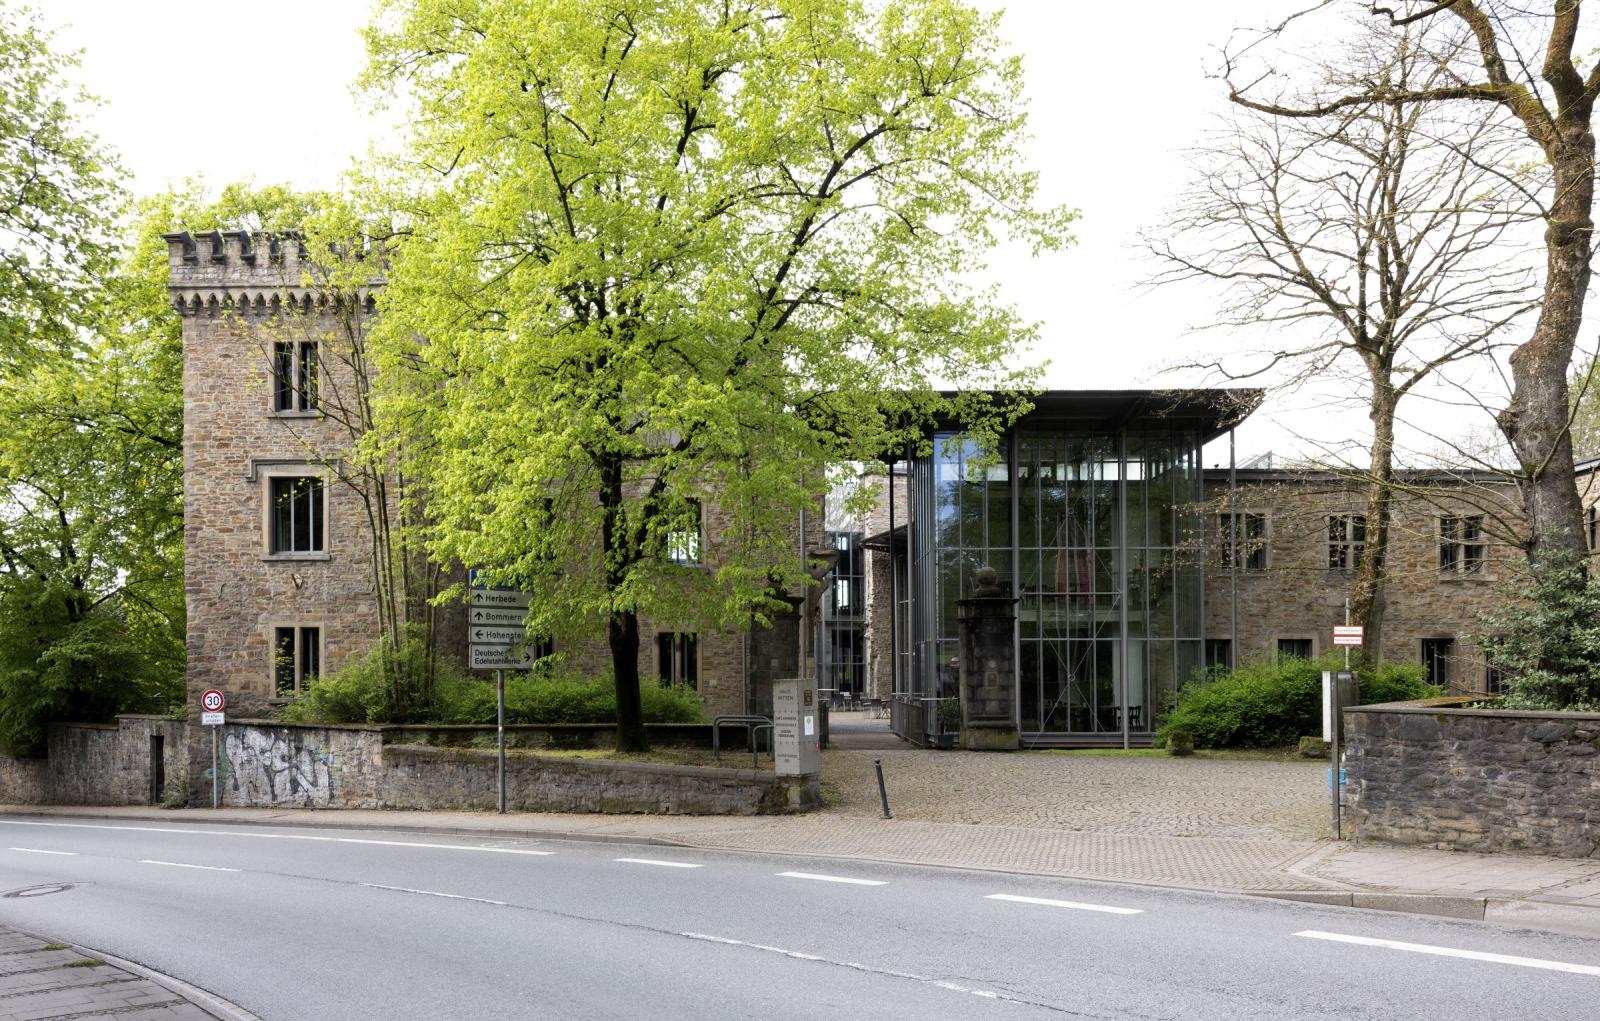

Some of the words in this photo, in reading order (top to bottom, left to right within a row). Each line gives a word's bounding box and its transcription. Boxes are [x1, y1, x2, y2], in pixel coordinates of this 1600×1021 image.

[485, 594, 517, 603] Herbede
[485, 612, 522, 621] Bommern
[486, 631, 526, 640] Hohenstei
[474, 649, 505, 657] Deutsche
[206, 695, 220, 706] 30
